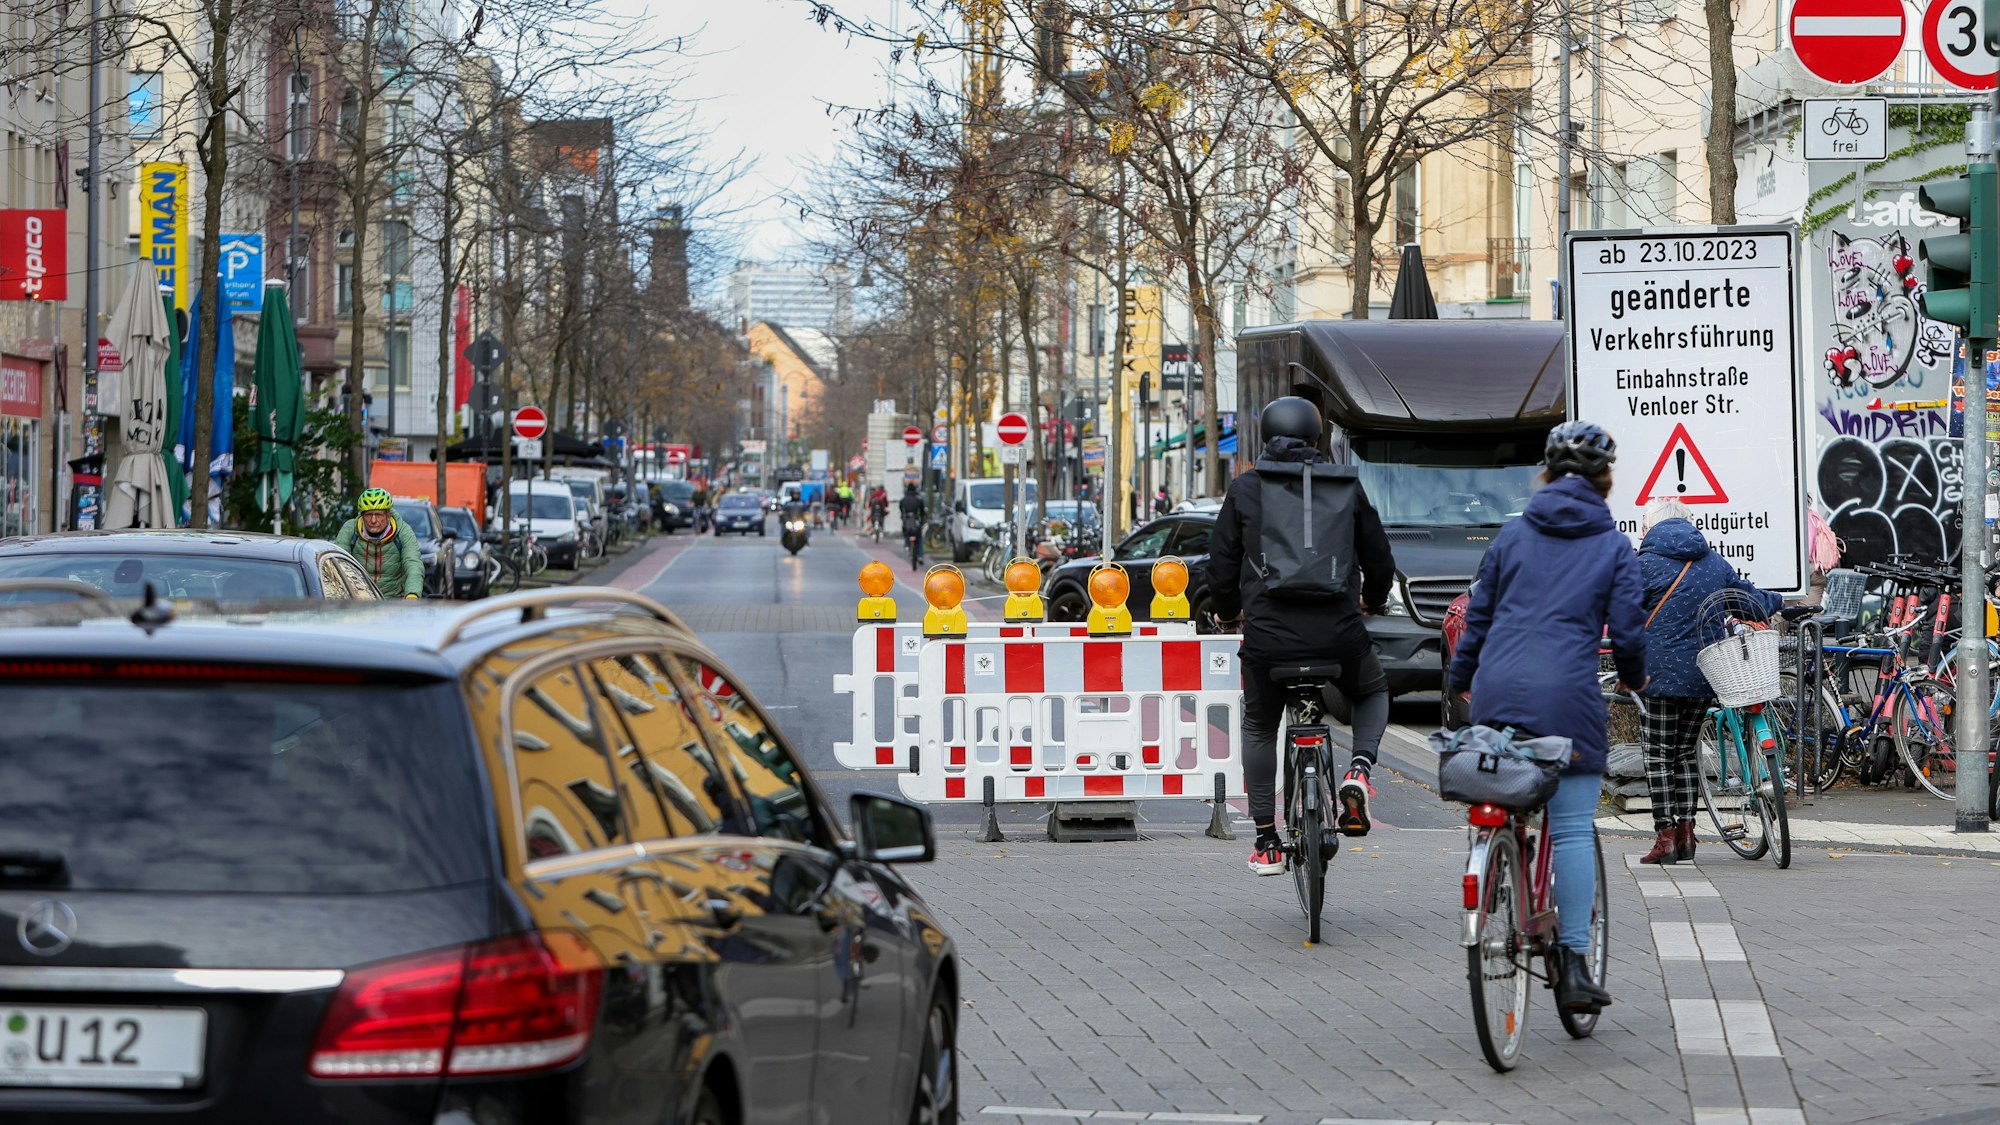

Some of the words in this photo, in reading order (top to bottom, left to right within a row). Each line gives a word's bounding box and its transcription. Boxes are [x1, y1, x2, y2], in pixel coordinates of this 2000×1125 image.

[1947, 6, 2000, 57] 3
[1832, 139, 1859, 153] frei
[152, 171, 176, 309] EEMAN
[1599, 243, 1626, 264] ab
[1640, 240, 1757, 263] 23.10.2023
[20, 216, 46, 293] tipico
[1611, 278, 1750, 319] geänderte
[1590, 324, 1774, 353] Verkehrsführung
[1616, 366, 1748, 389] Einbahnstraße
[1628, 395, 1698, 416] Venloer
[1706, 394, 1739, 414] Str.
[1693, 512, 1769, 534] eldgürtel
[1709, 541, 1754, 561] htung
[37, 1016, 69, 1064] U
[79, 1016, 143, 1066] 12
